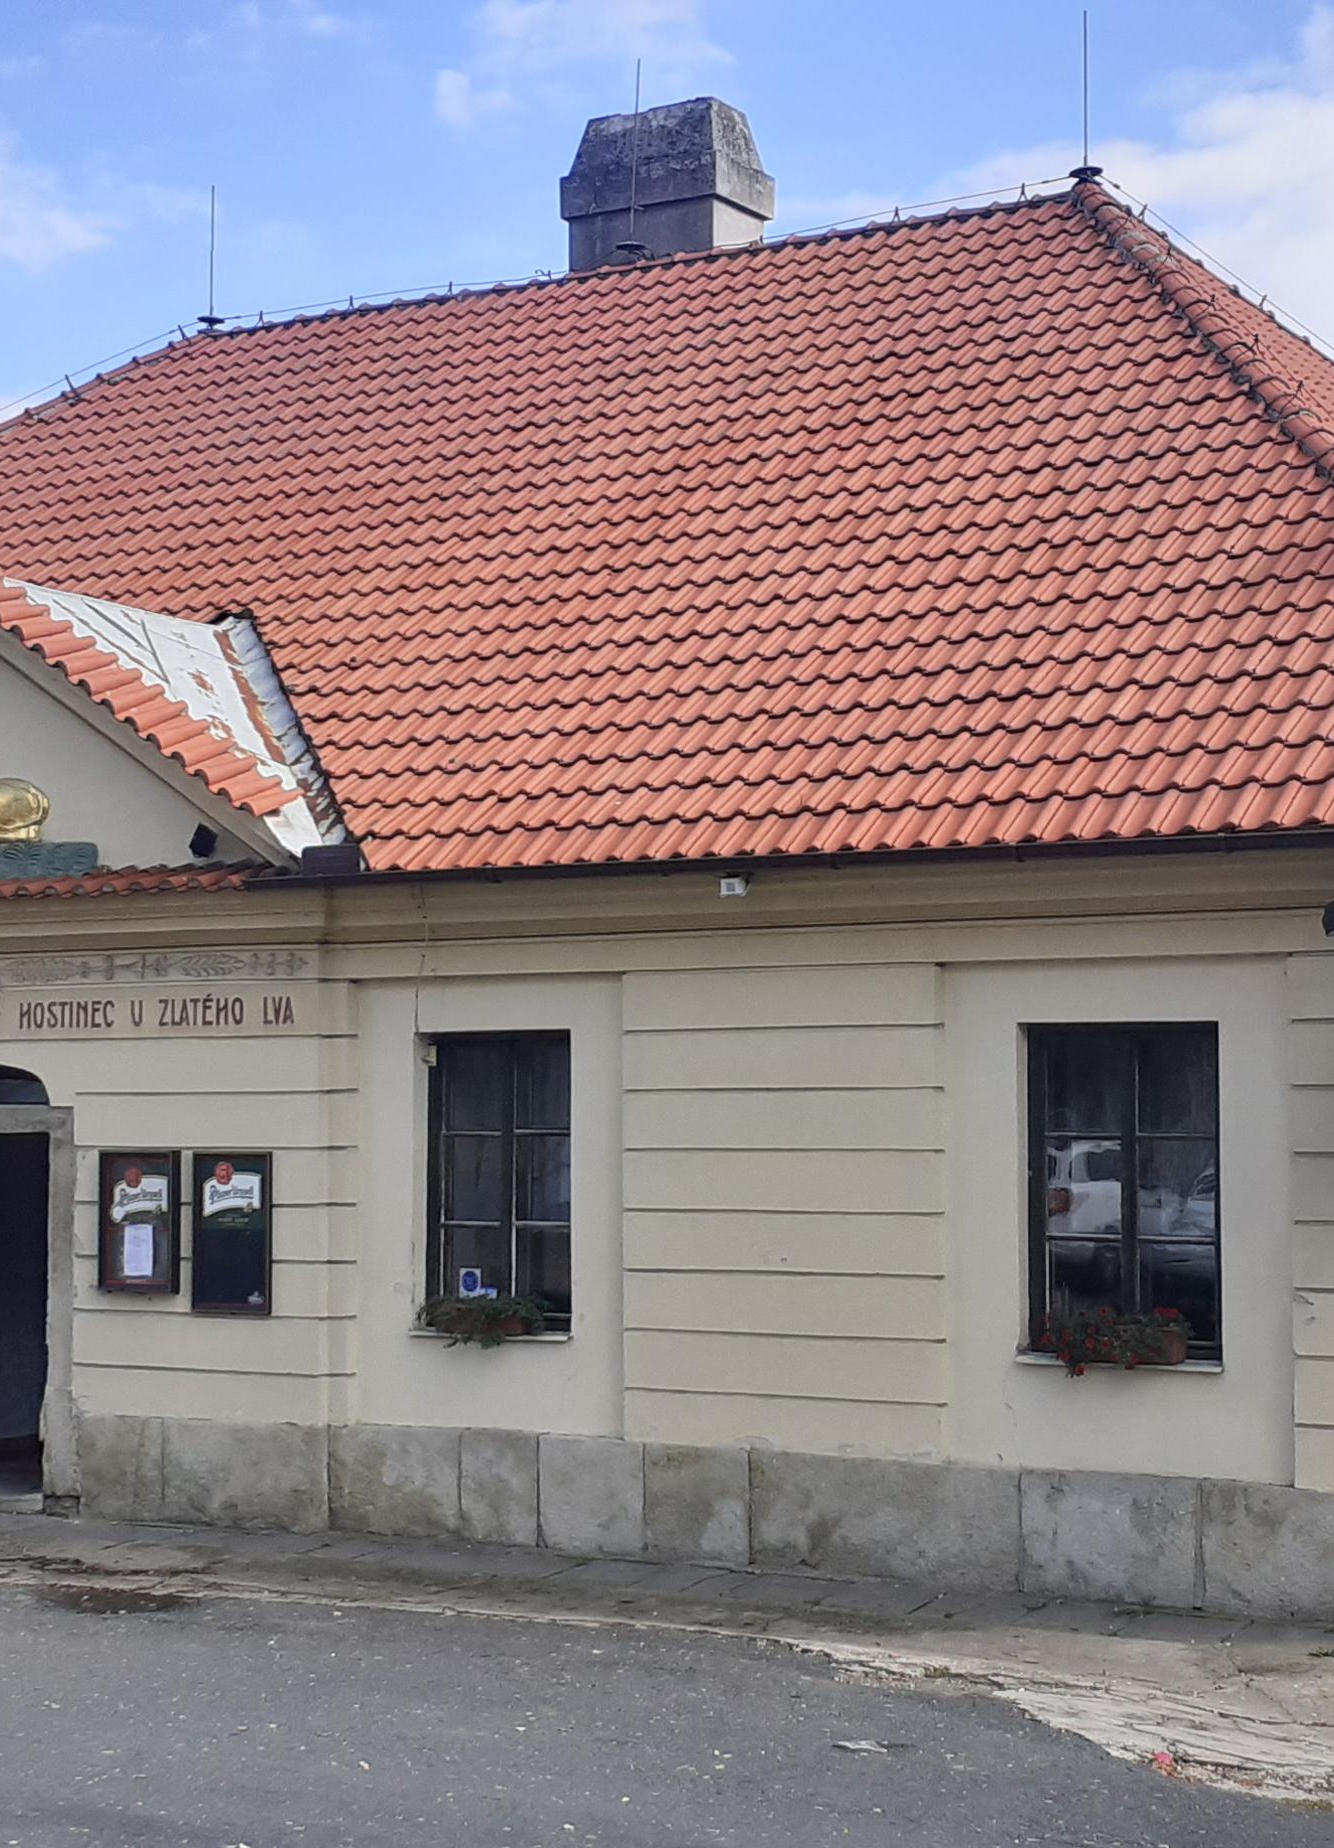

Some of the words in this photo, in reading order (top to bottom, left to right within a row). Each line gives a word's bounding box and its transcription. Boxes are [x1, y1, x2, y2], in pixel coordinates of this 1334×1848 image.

[19, 1000, 115, 1029] HOSTINEC
[131, 999, 144, 1027] U
[158, 993, 244, 1027] ZLATÉHO
[263, 996, 295, 1025] LVA
